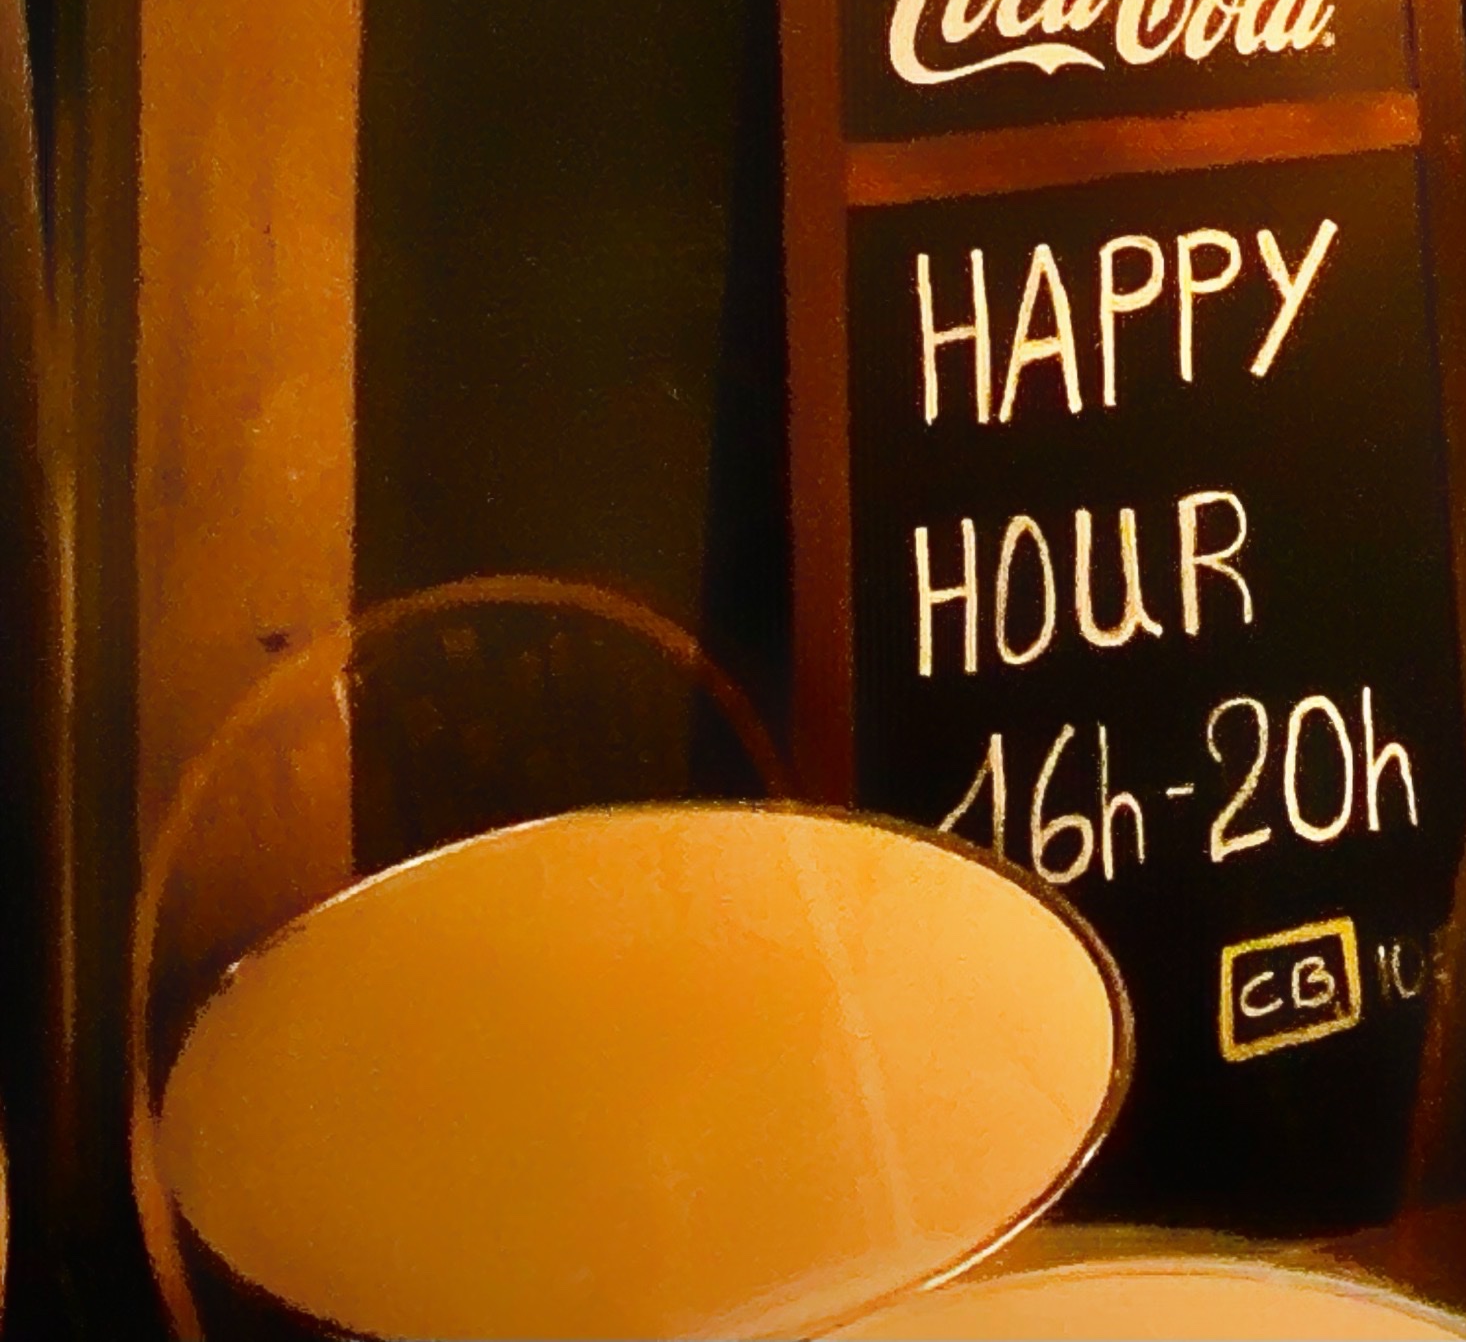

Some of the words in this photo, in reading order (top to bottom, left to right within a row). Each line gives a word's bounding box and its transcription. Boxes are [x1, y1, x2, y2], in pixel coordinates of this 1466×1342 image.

[917, 218, 1338, 425] HAPPY
[914, 489, 1254, 677] HOUR
[1240, 956, 1336, 1017] CB
